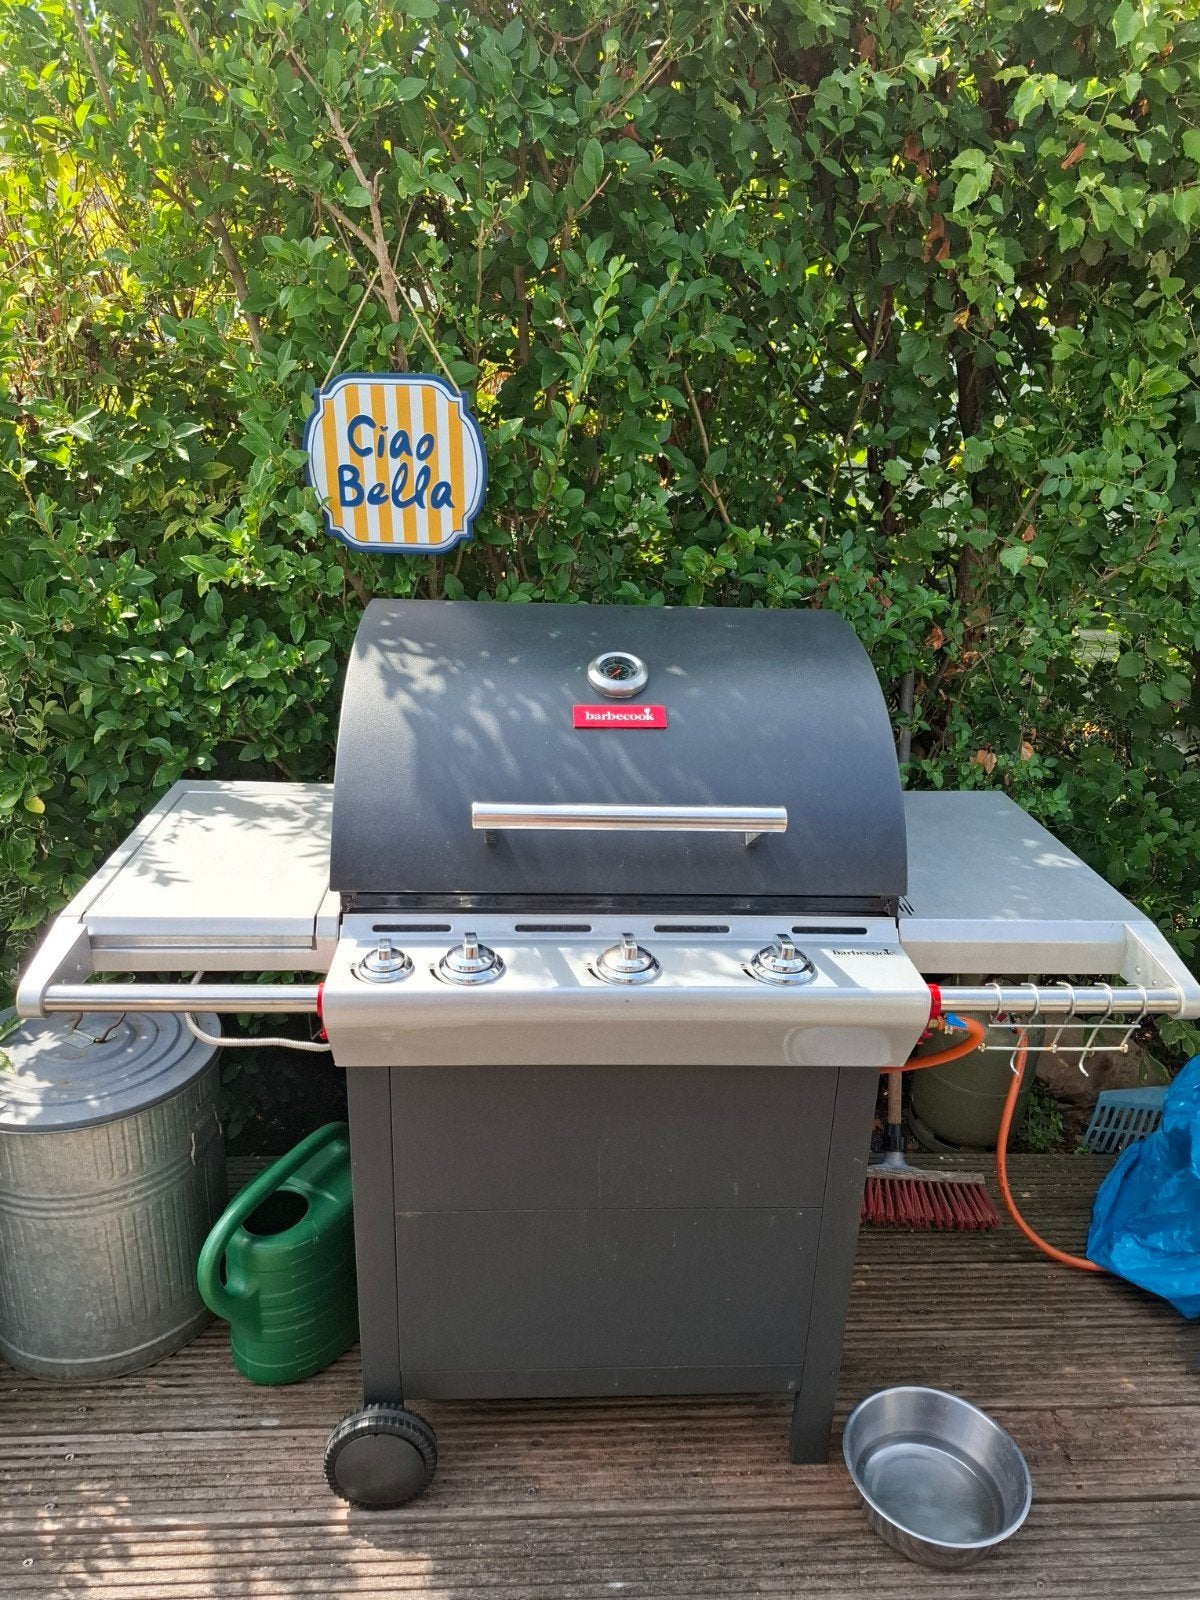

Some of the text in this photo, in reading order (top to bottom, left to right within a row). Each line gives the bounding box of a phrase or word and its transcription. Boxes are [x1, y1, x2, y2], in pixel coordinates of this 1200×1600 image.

[347, 414, 435, 461] Ciao
[337, 462, 456, 510] Bella
[585, 707, 655, 721] barbecook
